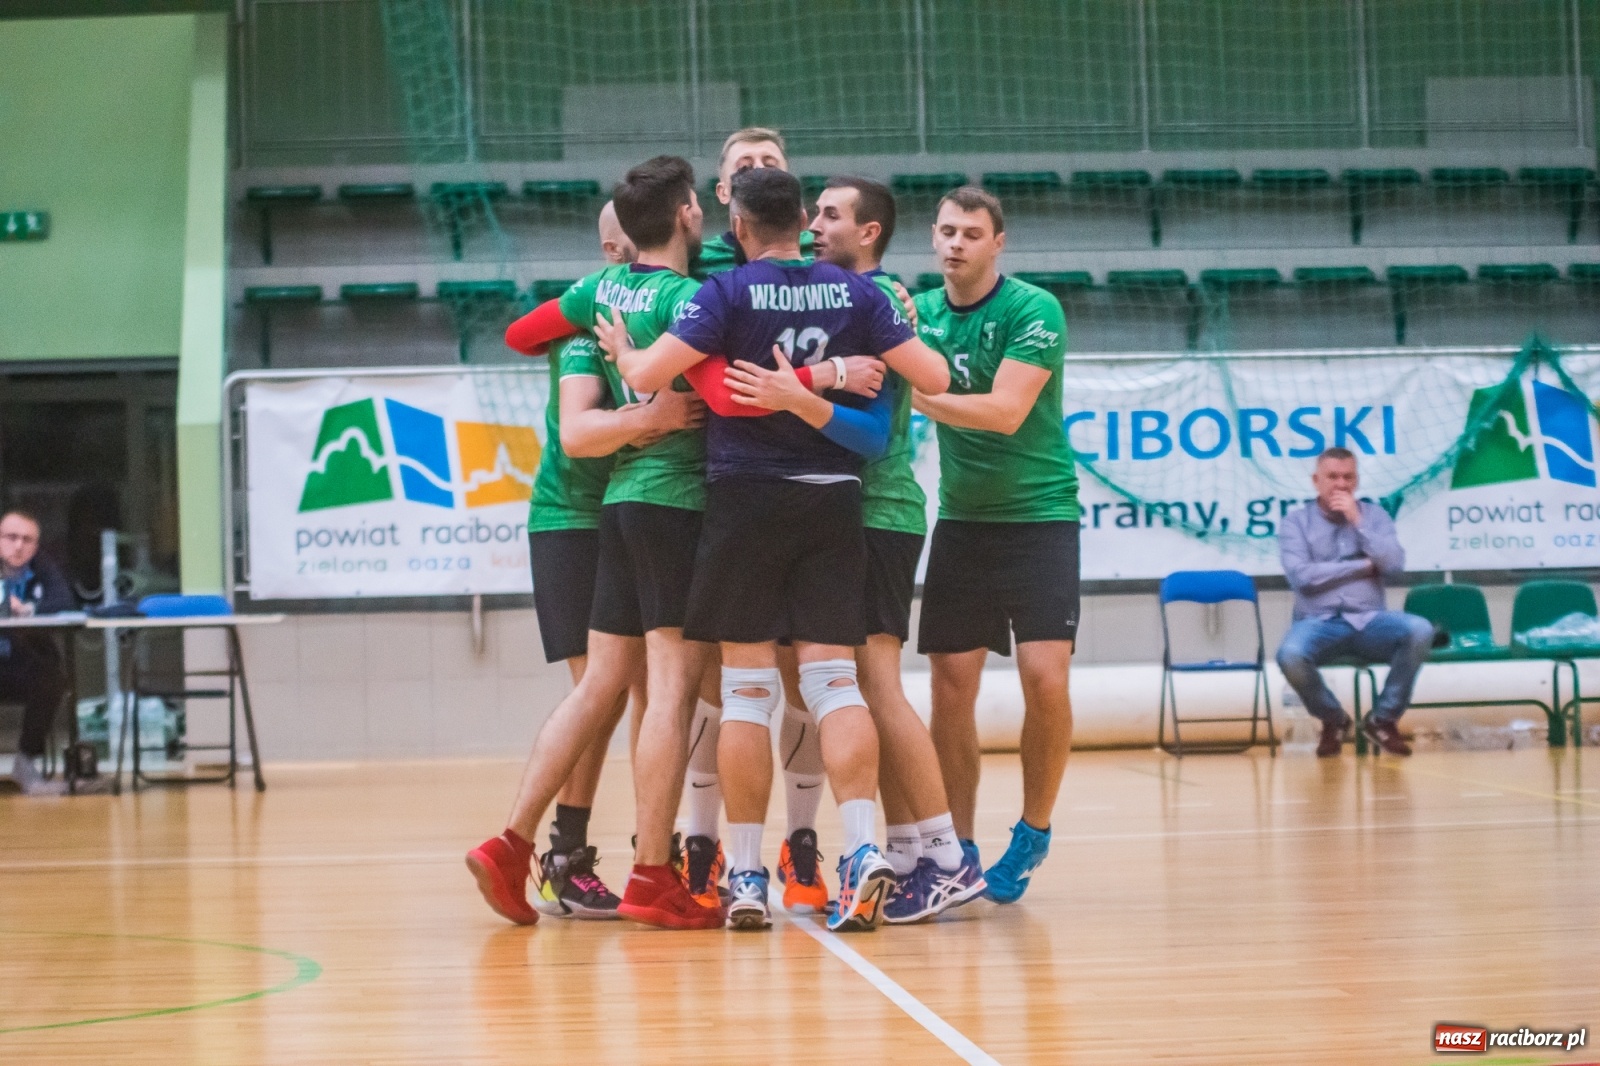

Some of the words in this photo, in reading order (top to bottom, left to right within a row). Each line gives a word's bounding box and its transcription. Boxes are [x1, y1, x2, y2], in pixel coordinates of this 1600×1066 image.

[953, 353, 972, 390] 5
[1449, 497, 1545, 531] powiat
[296, 520, 400, 555] powiat
[1451, 532, 1535, 550] zielona
[297, 557, 388, 575] zielona
[408, 556, 471, 571] oaza
